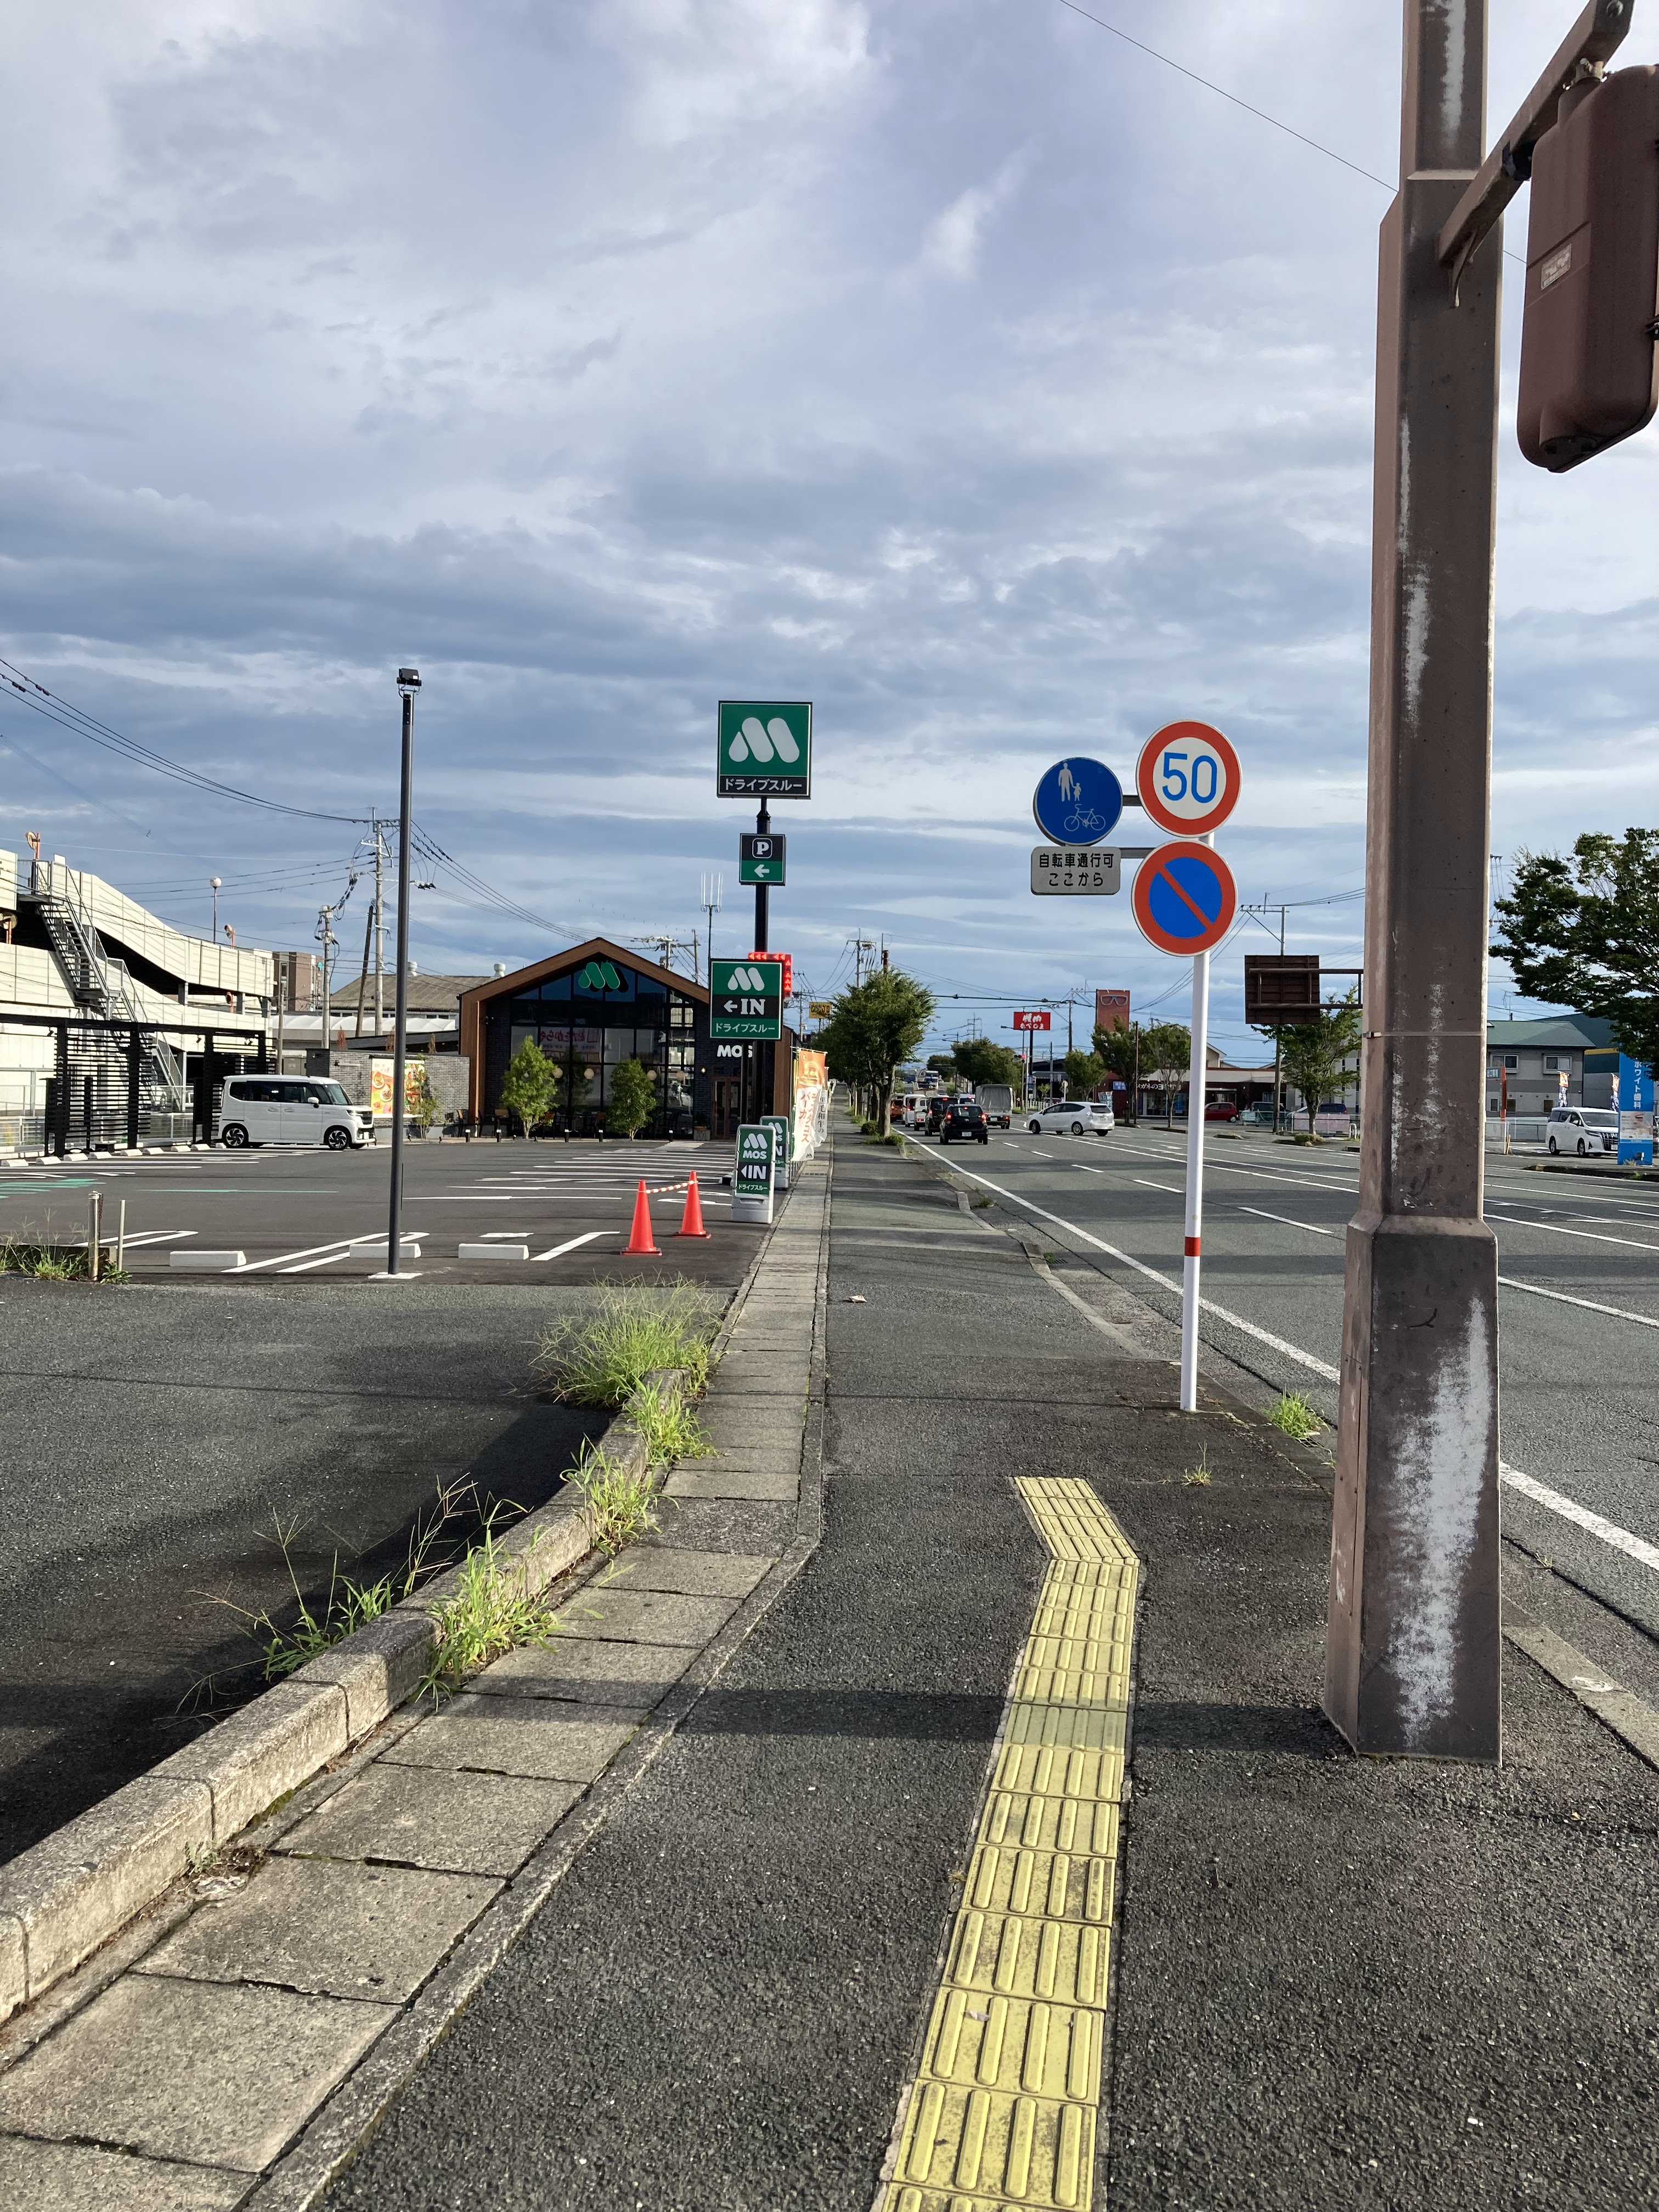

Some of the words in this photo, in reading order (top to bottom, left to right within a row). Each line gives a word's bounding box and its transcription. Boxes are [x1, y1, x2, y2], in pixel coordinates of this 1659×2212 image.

[725, 778, 802, 791] ドライブスルー
[1163, 752, 1217, 803] 50
[757, 842, 769, 855] P
[1039, 853, 1114, 868] 自転車通行可
[1048, 872, 1104, 887] ここから
[741, 998, 765, 1015] IN
[715, 1023, 775, 1032] ドライブスルー
[742, 1150, 767, 1159] MOS
[748, 1165, 766, 1180] IN
